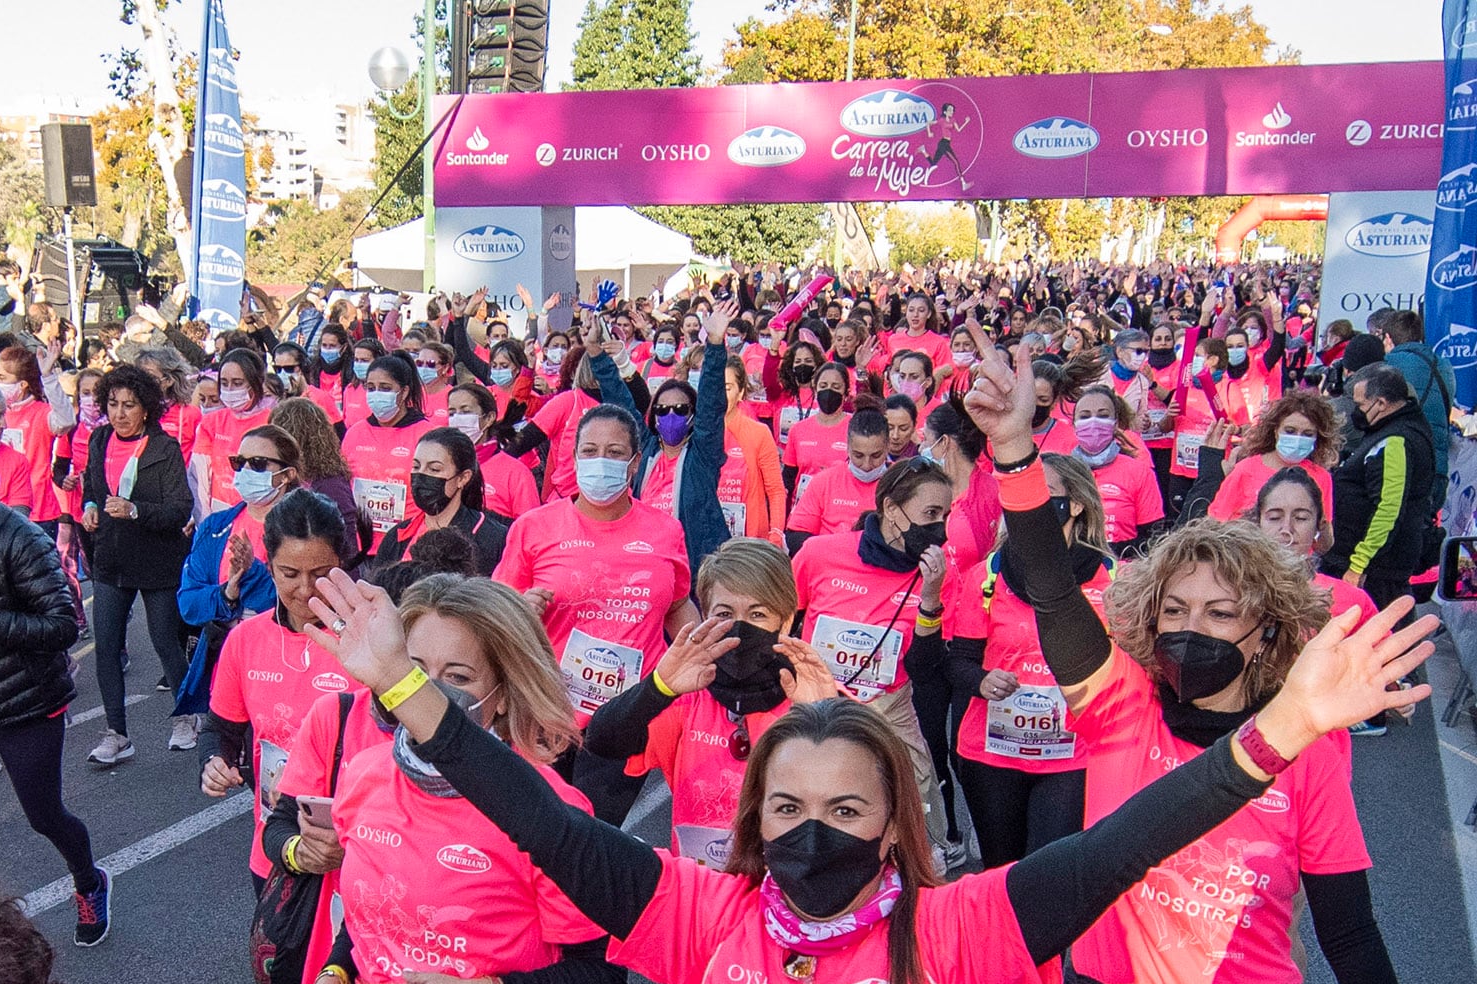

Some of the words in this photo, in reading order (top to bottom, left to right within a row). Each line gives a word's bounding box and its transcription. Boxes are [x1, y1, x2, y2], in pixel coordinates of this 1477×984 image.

[849, 110, 928, 127] ASTURIANA
[1020, 133, 1092, 149] ASTURIANA
[1127, 128, 1208, 147] OYSHO
[1235, 130, 1316, 147] Santander
[563, 148, 618, 161] ZURICH
[641, 144, 711, 161] OYSHO
[736, 137, 799, 158] ASTURIANA
[831, 134, 909, 163] Carrera
[446, 151, 509, 166] Santander
[850, 163, 865, 177] de
[866, 163, 878, 177] la
[875, 158, 938, 197] Mujer
[459, 239, 519, 253] ASTURIANA
[1353, 229, 1431, 247] ASTURIAN
[367, 499, 389, 511] 016
[559, 539, 595, 550] OYSHO
[624, 586, 651, 597] POR
[831, 578, 868, 595] OYSHO
[605, 598, 648, 611] TODAS
[577, 611, 645, 624] NOSOTRAS
[836, 650, 871, 669] 016
[247, 669, 284, 683] OYSHO
[582, 667, 616, 688] 016
[1014, 715, 1051, 730] 016
[356, 824, 402, 848] OYSHO
[440, 852, 488, 870] ASTURIANA
[1225, 864, 1271, 890] POR
[1191, 877, 1258, 907] TODAS
[1140, 883, 1252, 929] NOSOTRAS
[424, 931, 467, 953] POR
[402, 943, 466, 973] TODAS
